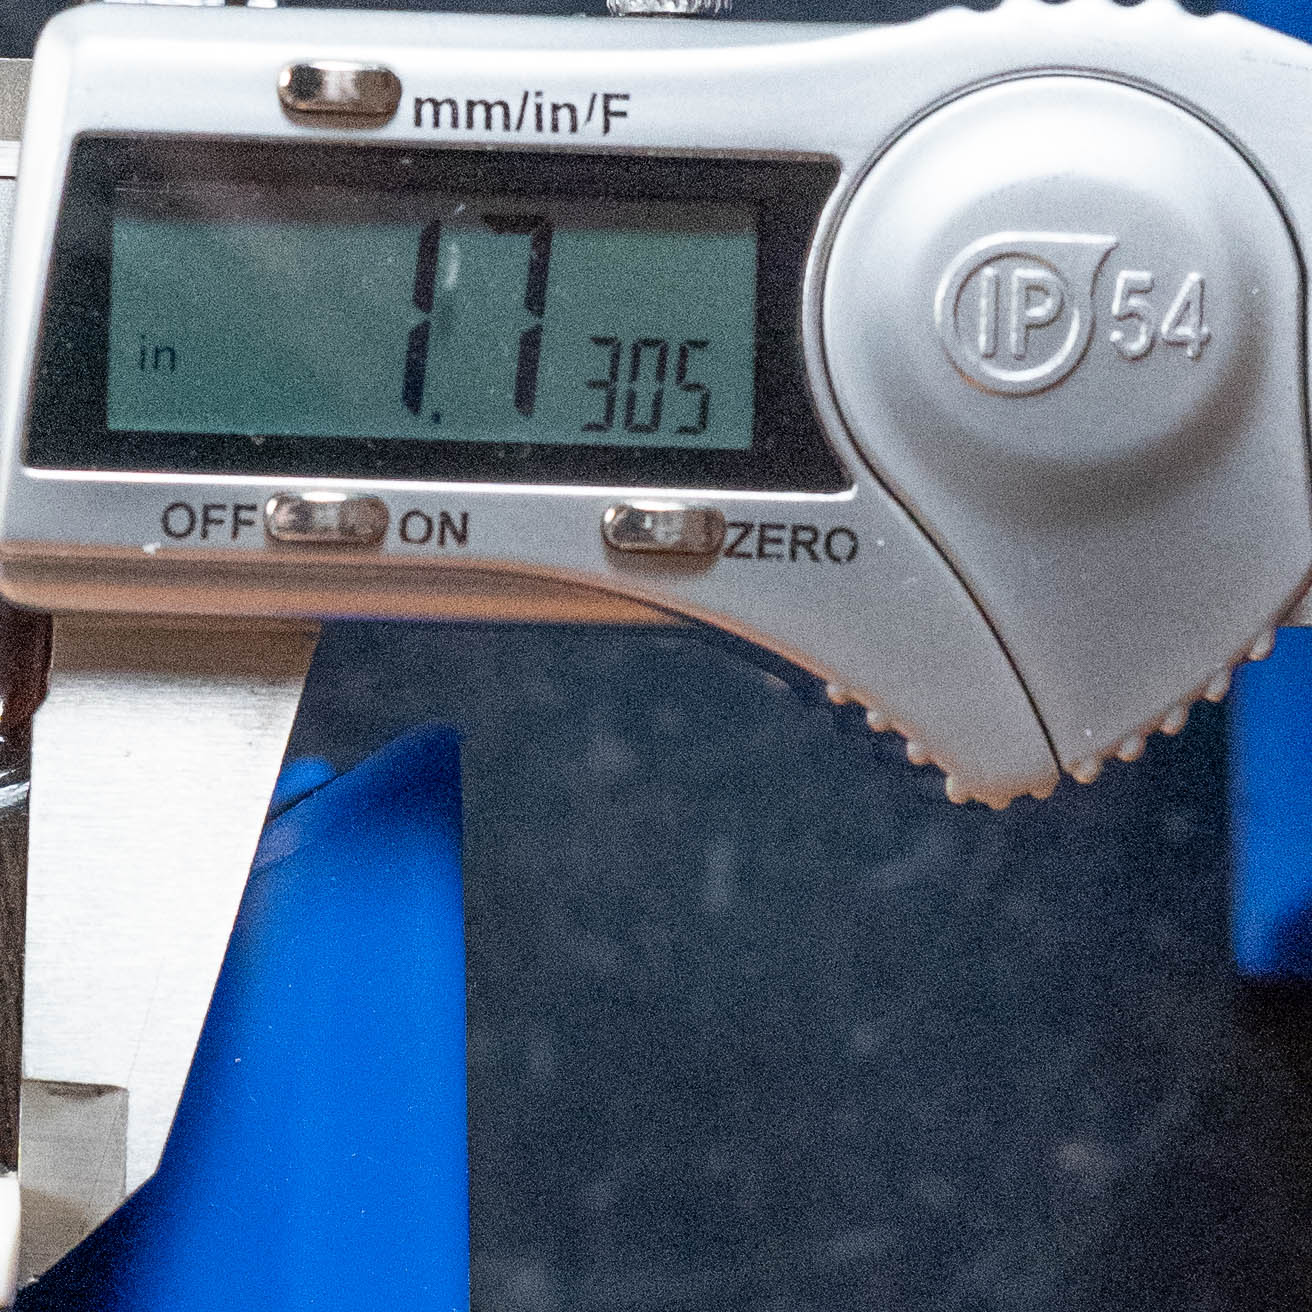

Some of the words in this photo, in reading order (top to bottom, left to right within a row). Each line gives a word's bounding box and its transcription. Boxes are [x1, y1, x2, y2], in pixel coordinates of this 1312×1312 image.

[413, 92, 631, 136] mm/in/F
[978, 266, 1066, 360] IP
[1109, 270, 1213, 360] 54
[138, 334, 178, 372] in
[161, 501, 258, 540] OFF
[398, 509, 470, 547] ON
[723, 520, 859, 565] ZERO
